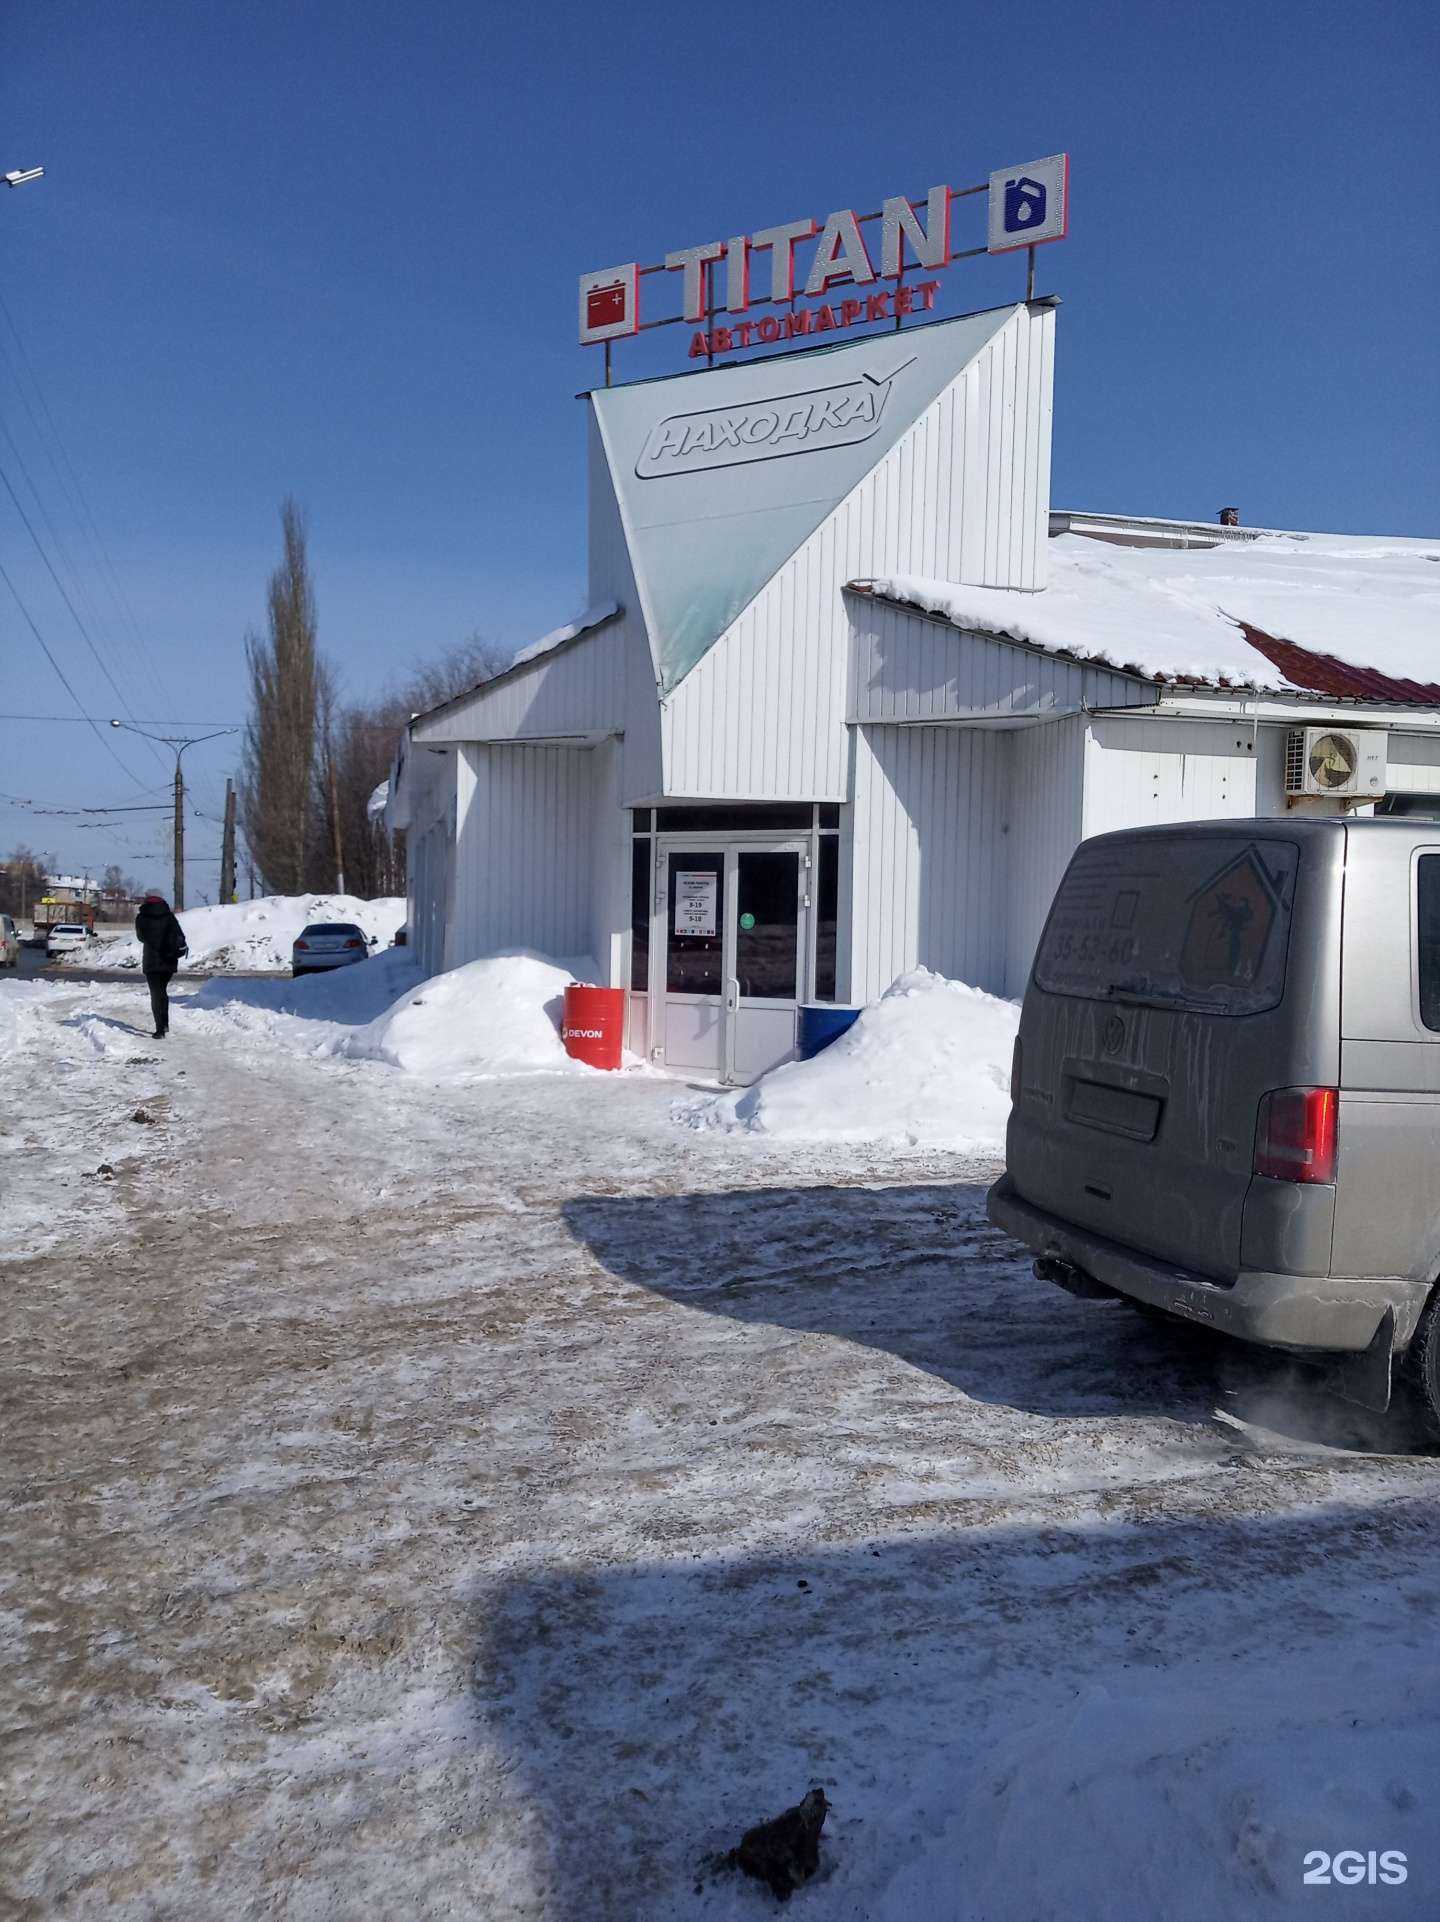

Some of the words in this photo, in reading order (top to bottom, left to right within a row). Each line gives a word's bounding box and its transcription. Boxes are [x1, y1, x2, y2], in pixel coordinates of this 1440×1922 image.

[664, 184, 951, 324] TITAN
[688, 280, 942, 358] АВТОМАРКЕТ
[650, 392, 877, 461] НАХОДКА
[568, 1029, 603, 1039] DEVON
